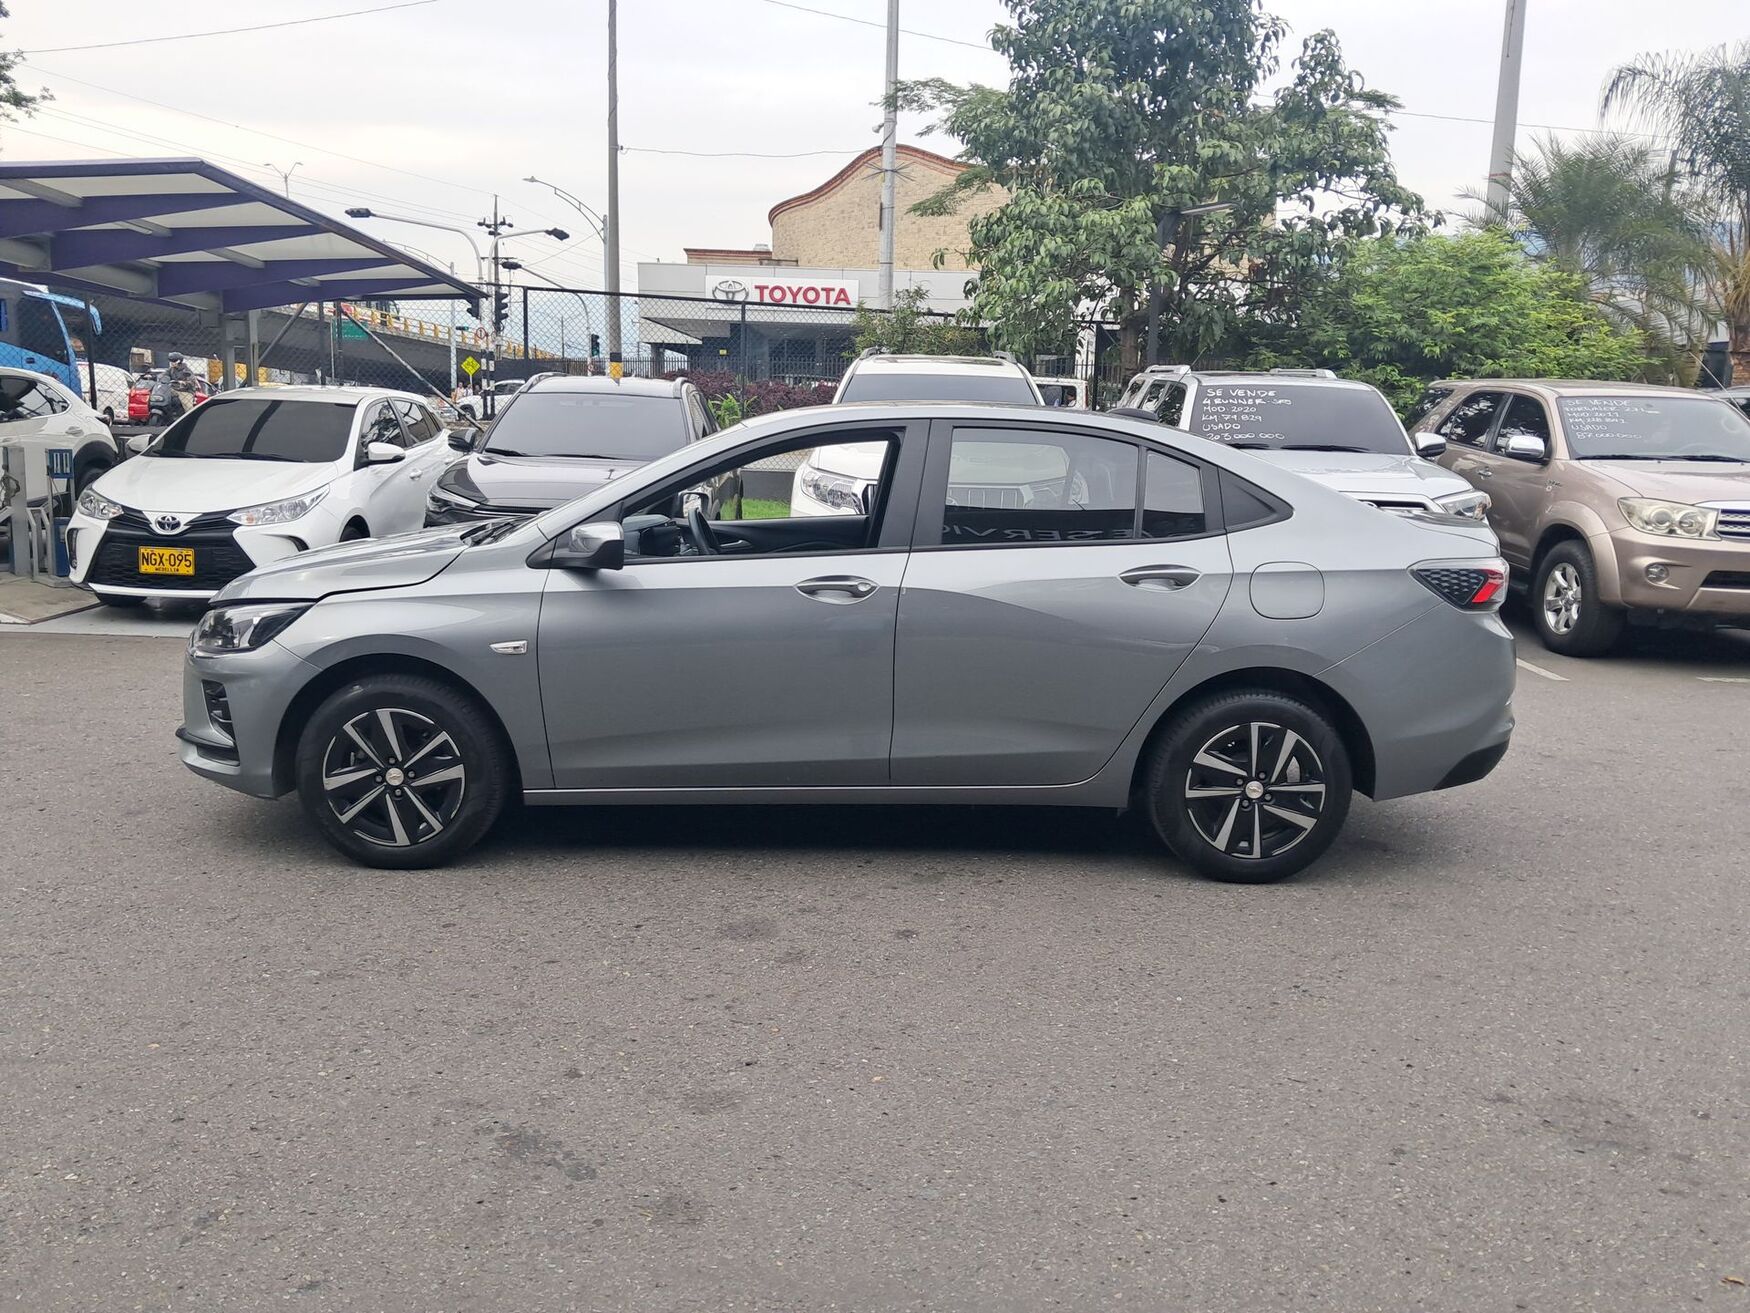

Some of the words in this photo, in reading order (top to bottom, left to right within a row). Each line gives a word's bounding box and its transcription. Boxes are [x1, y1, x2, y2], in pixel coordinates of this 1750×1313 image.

[754, 285, 852, 305] TOYOTA
[1206, 388, 1224, 397] SE
[1229, 389, 1277, 398] VENDE
[1231, 405, 1257, 413] 2020
[1202, 423, 1241, 431] USADO
